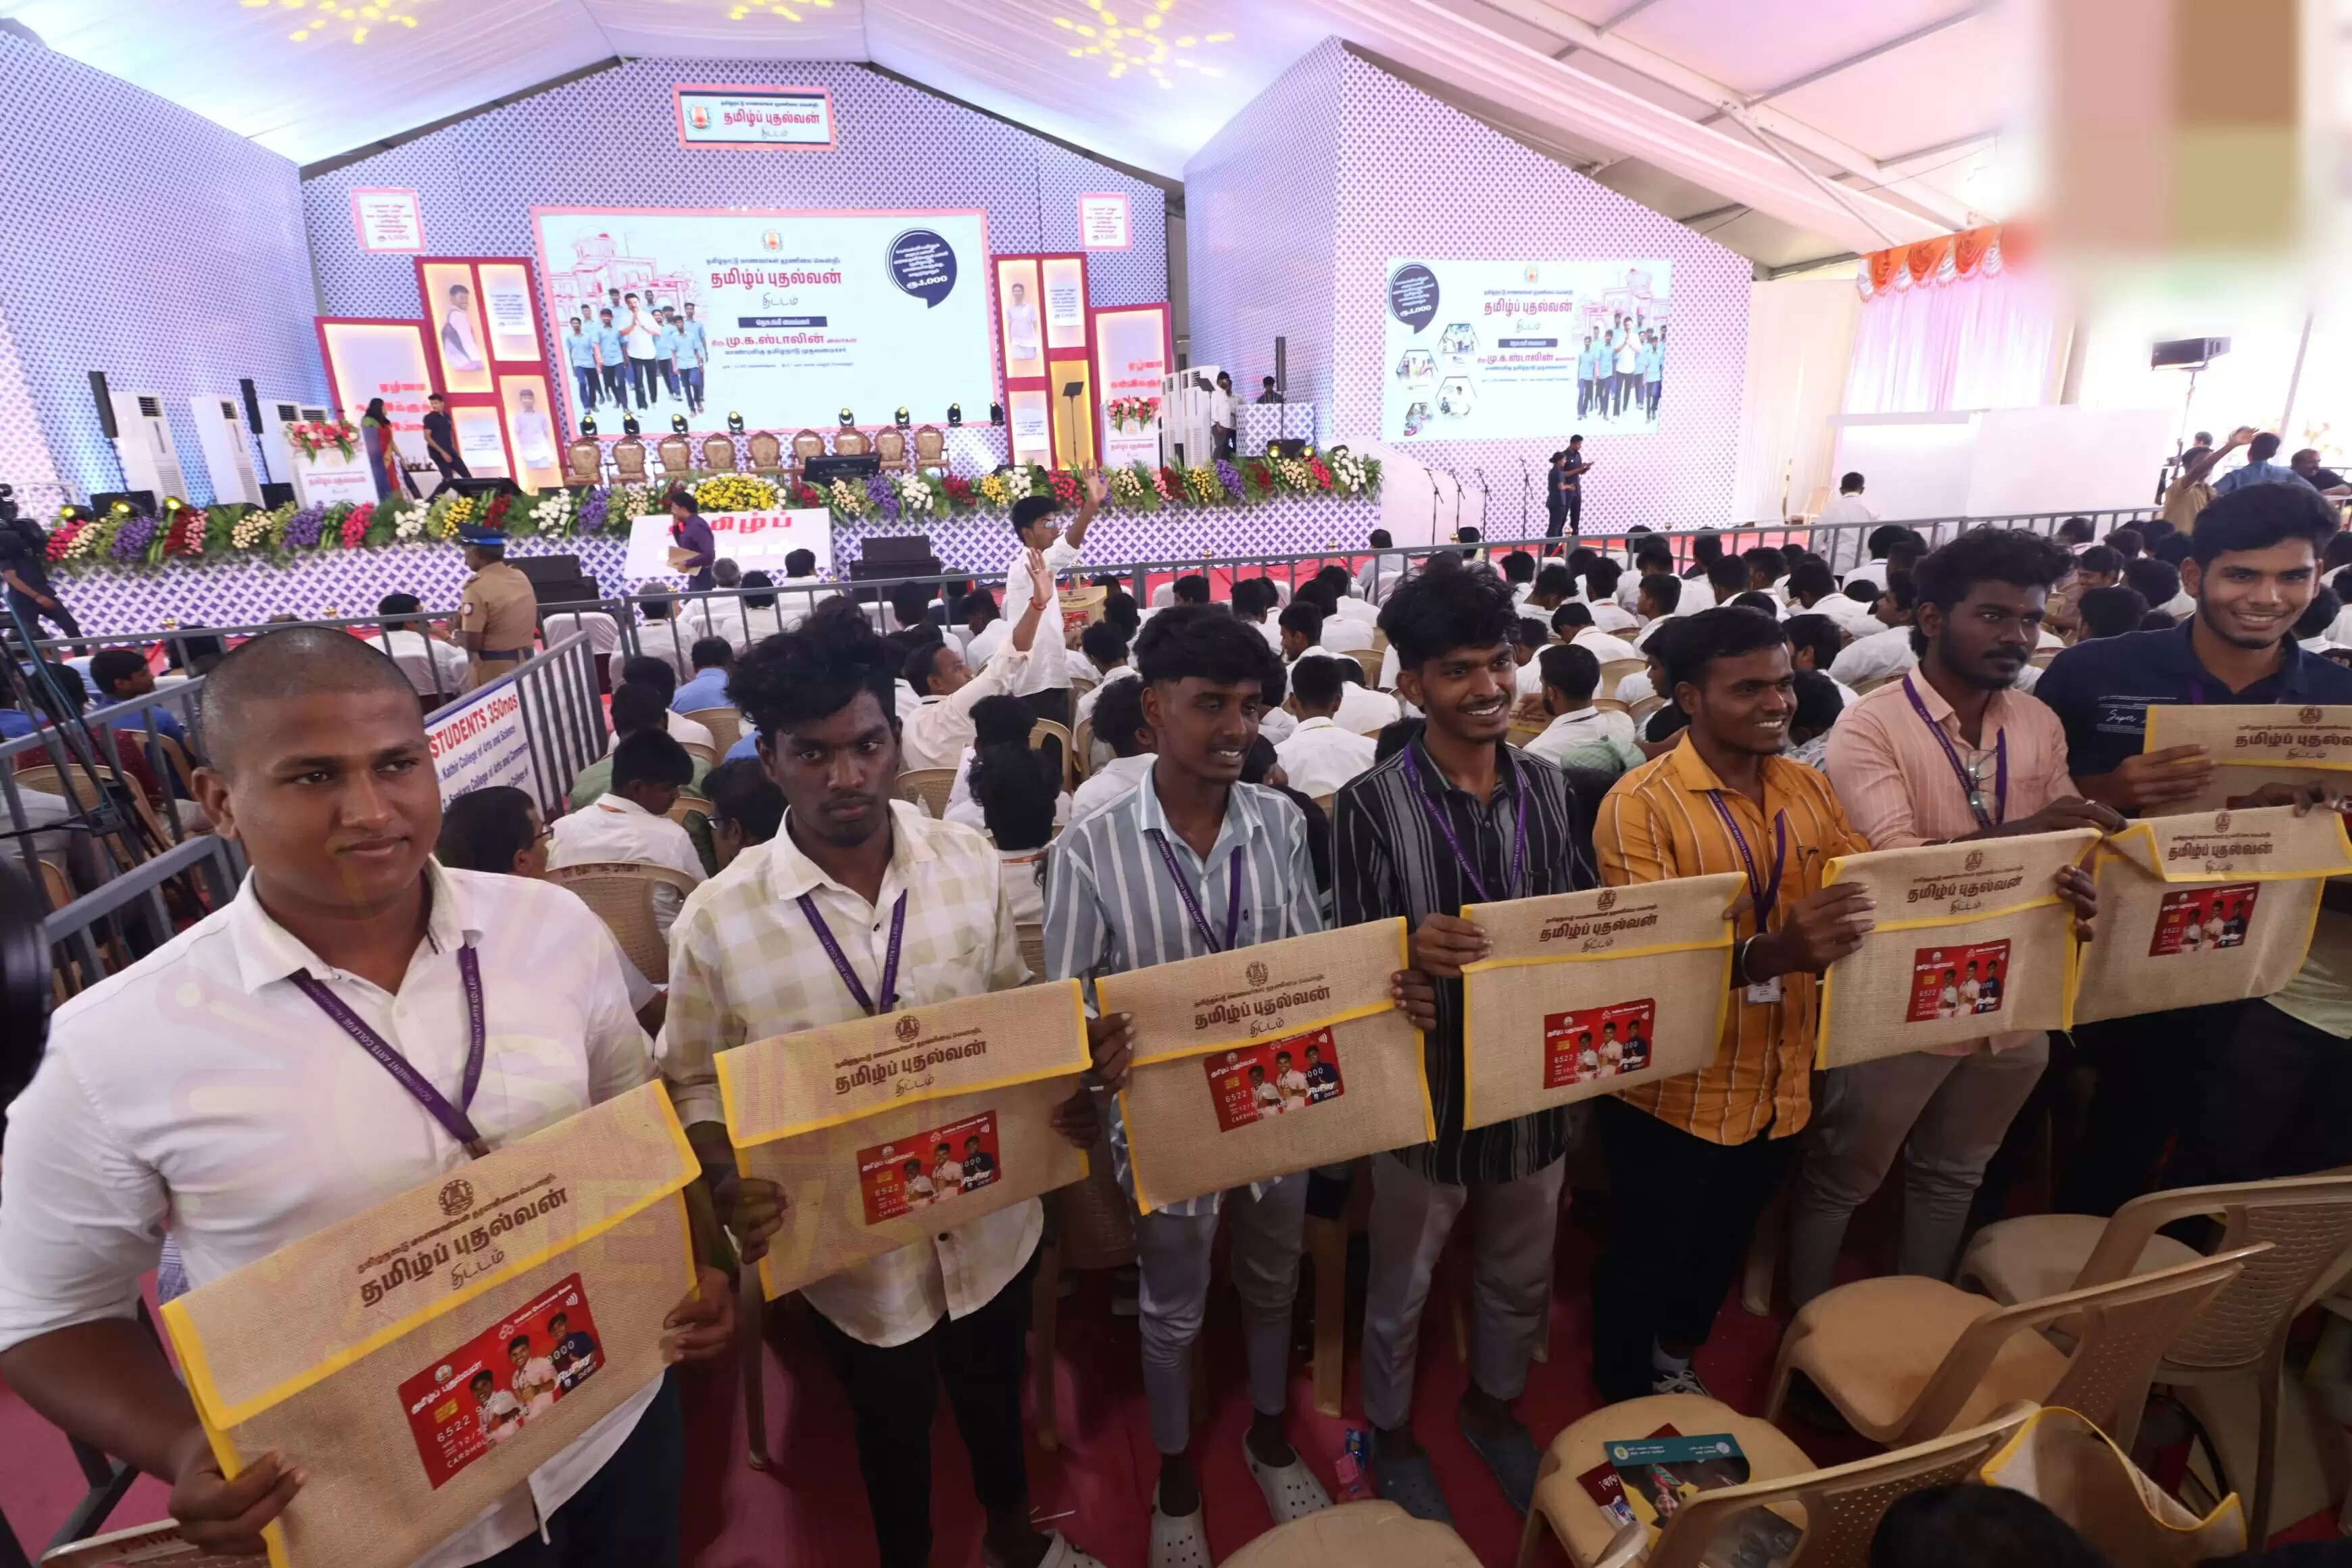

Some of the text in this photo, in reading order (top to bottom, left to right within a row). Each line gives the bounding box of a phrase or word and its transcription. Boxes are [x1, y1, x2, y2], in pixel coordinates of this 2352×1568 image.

[724, 109, 820, 127] தமிழ்ப் புதல்வன்
[711, 267, 842, 290] தமிழ்ப் புதல்வன்
[1484, 297, 1573, 317] தமிழ்ப் புதல்வன்
[726, 333, 825, 348] மு.க.ஸ்டாலின்
[1487, 351, 1554, 364] மு.க.ஸ்டாலின்
[429, 708, 487, 758] STUDENTS
[2234, 731, 2293, 748] தமிழ்ப்
[459, 751, 479, 769] College
[2167, 841, 2273, 860] தமிழ்ப் புதல்வன்
[1907, 875, 2023, 903] தமிழ்ப் புதல்வன்
[1540, 914, 1659, 942] தமிழ்ப் புதல்வன்
[472, 1005, 481, 1022] ARTS
[1194, 985, 1330, 1030] தமிழ்ப் புதல்வன்
[341, 1016, 375, 1048] COLLEGE
[370, 1044, 392, 1064] ARTS
[835, 1039, 987, 1095] தமிழ்ப் புதல்வன்
[1225, 1090, 1247, 1102] 6522
[1308, 1080, 1336, 1096] RuPay
[360, 1187, 568, 1308] தமிழ்ப் புதல்வன்
[451, 1248, 504, 1290] திட்டம்
[557, 1351, 592, 1386] RuPay
[577, 1360, 597, 1380] DEBIT
[436, 1413, 471, 1445] 6522
